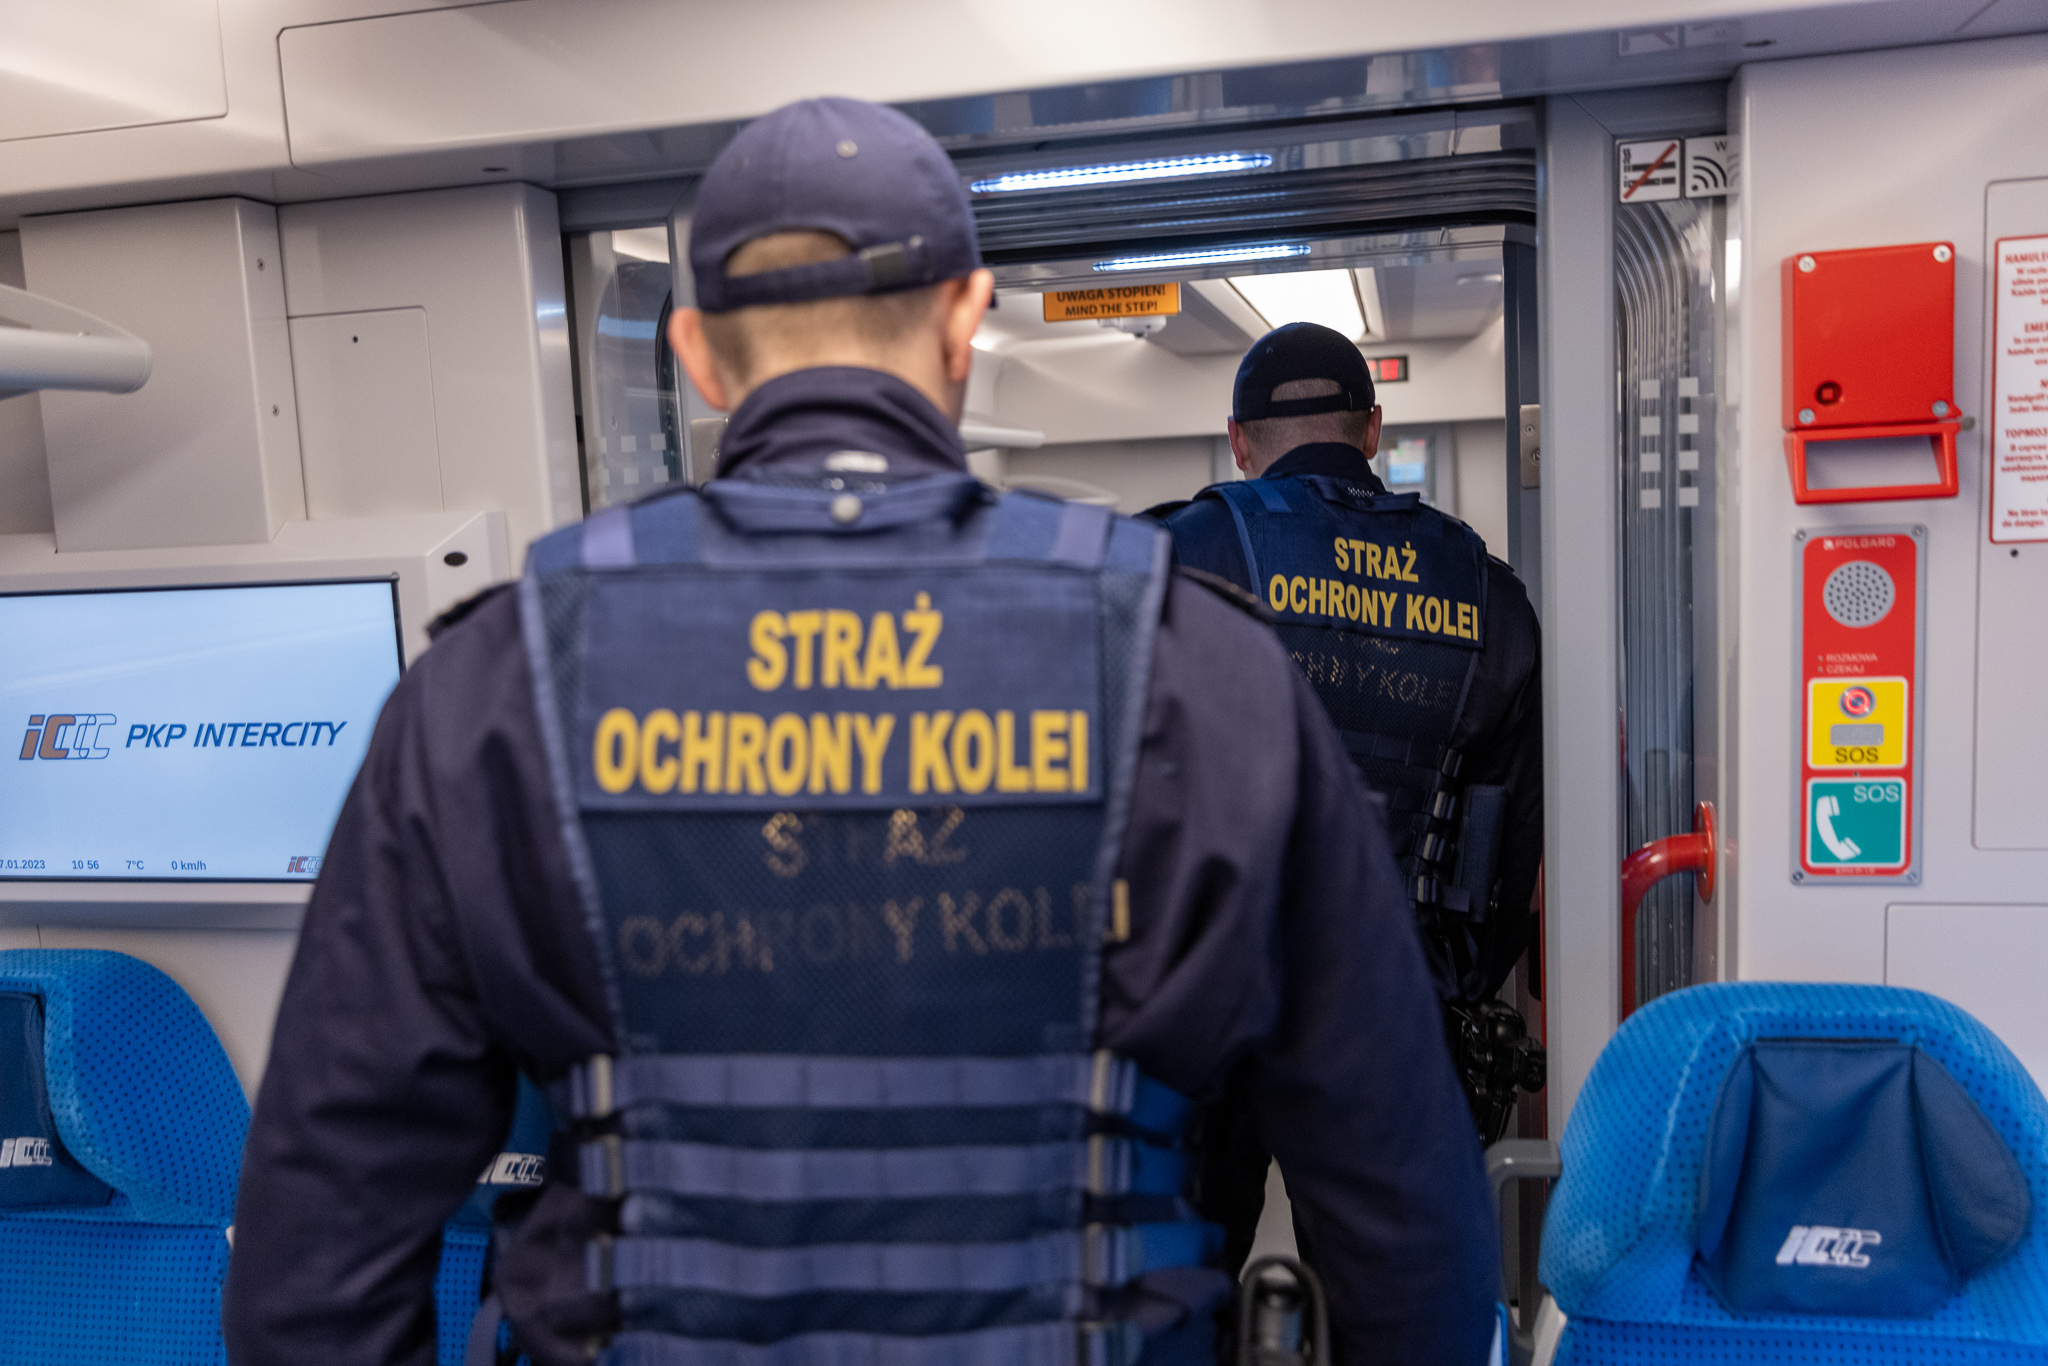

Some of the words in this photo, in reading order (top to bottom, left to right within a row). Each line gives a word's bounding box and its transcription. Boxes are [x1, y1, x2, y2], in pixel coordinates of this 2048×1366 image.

[1065, 304, 1098, 317] MIND
[1099, 302, 1123, 315] THE
[1125, 300, 1158, 313] STEP!
[1334, 536, 1419, 583] STRAŻ
[1269, 573, 1399, 628] OCHRONY
[1406, 592, 1480, 641] KOLEI
[746, 590, 945, 692] STRAŻ
[126, 723, 188, 748] PKP
[193, 721, 348, 748] INTERCITY
[592, 706, 897, 798] OCHRONY
[907, 706, 1091, 797] KOLEI
[1835, 746, 1879, 764] SOS
[1853, 784, 1900, 804] SOS
[0, 859, 46, 870] 7.01.2023
[125, 860, 145, 871] 7°C
[171, 860, 178, 871] 0
[180, 860, 207, 872] km/h
